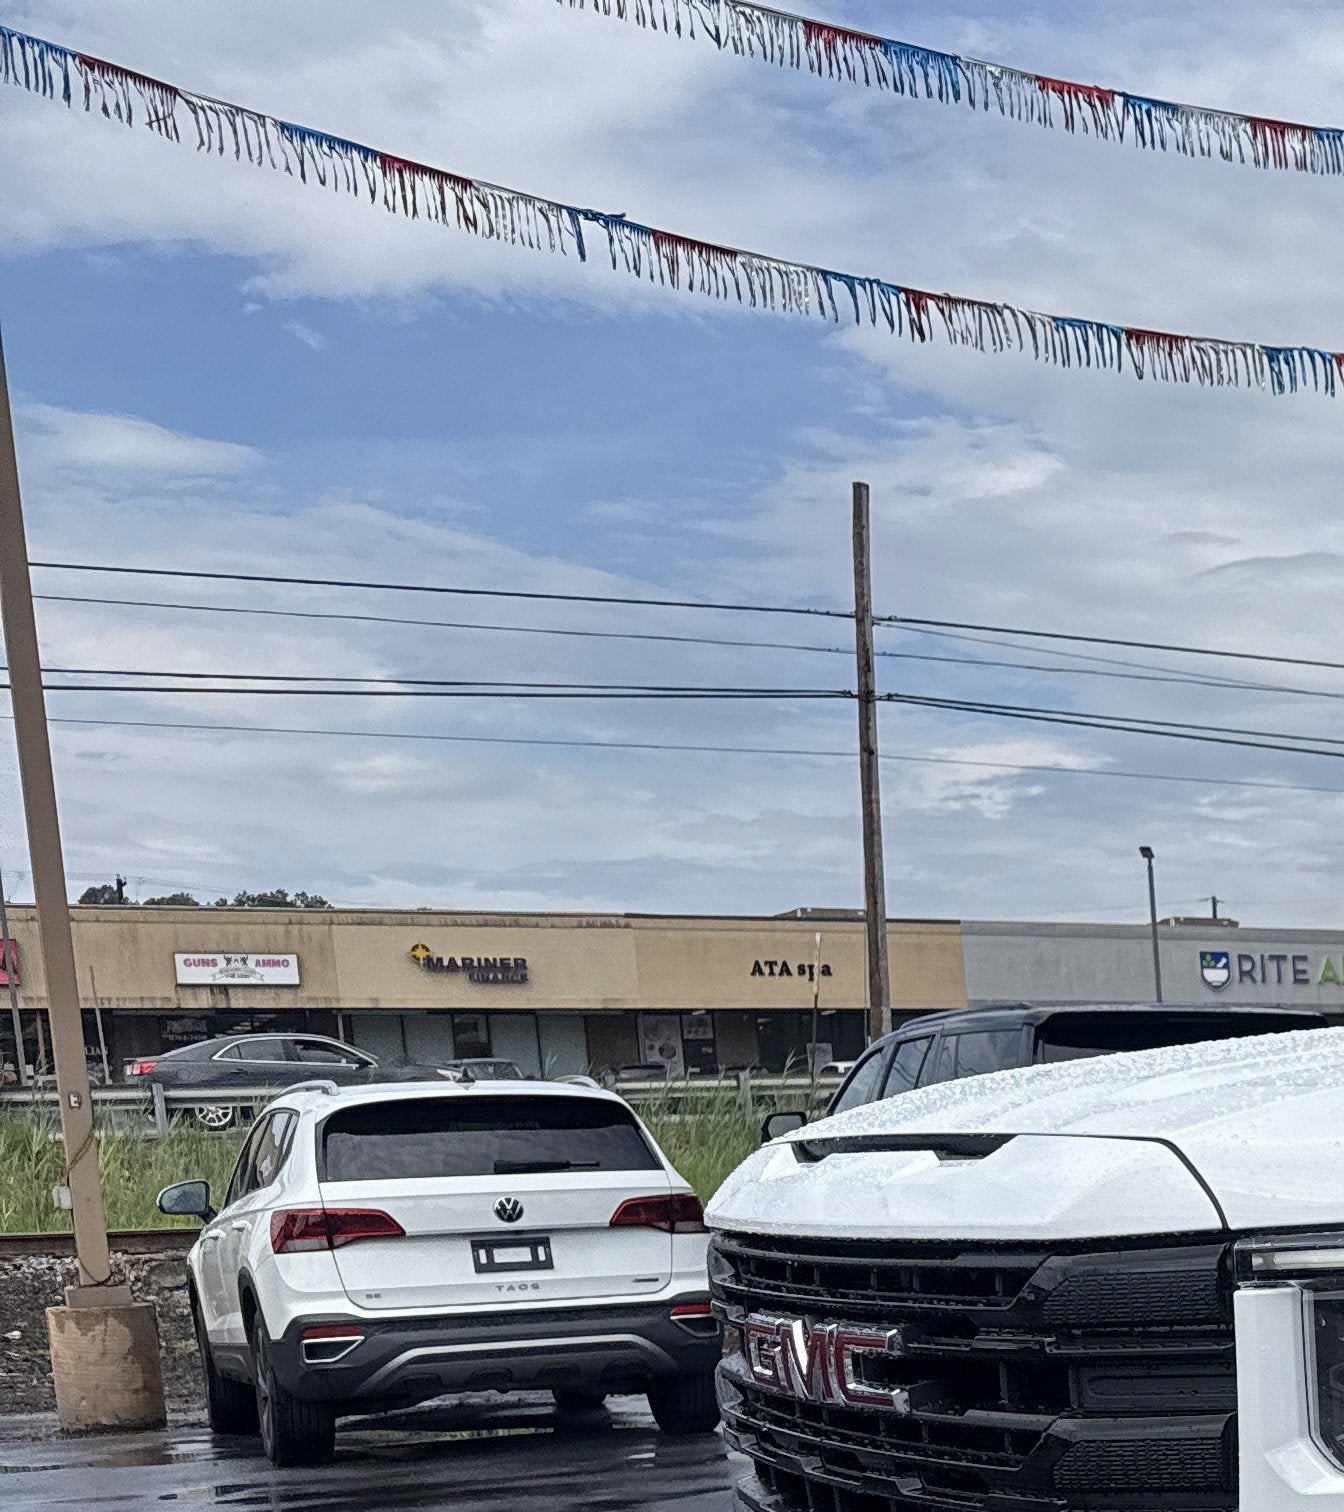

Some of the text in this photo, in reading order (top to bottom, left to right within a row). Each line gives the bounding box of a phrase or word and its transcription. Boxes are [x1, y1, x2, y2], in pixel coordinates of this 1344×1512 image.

[183, 957, 290, 968] GUNS AMMO
[425, 956, 529, 972] MARINER
[750, 959, 793, 977] ATA
[1237, 953, 1310, 985] RITE
[495, 1282, 540, 1292] TAOS
[743, 1311, 909, 1414] GMC
